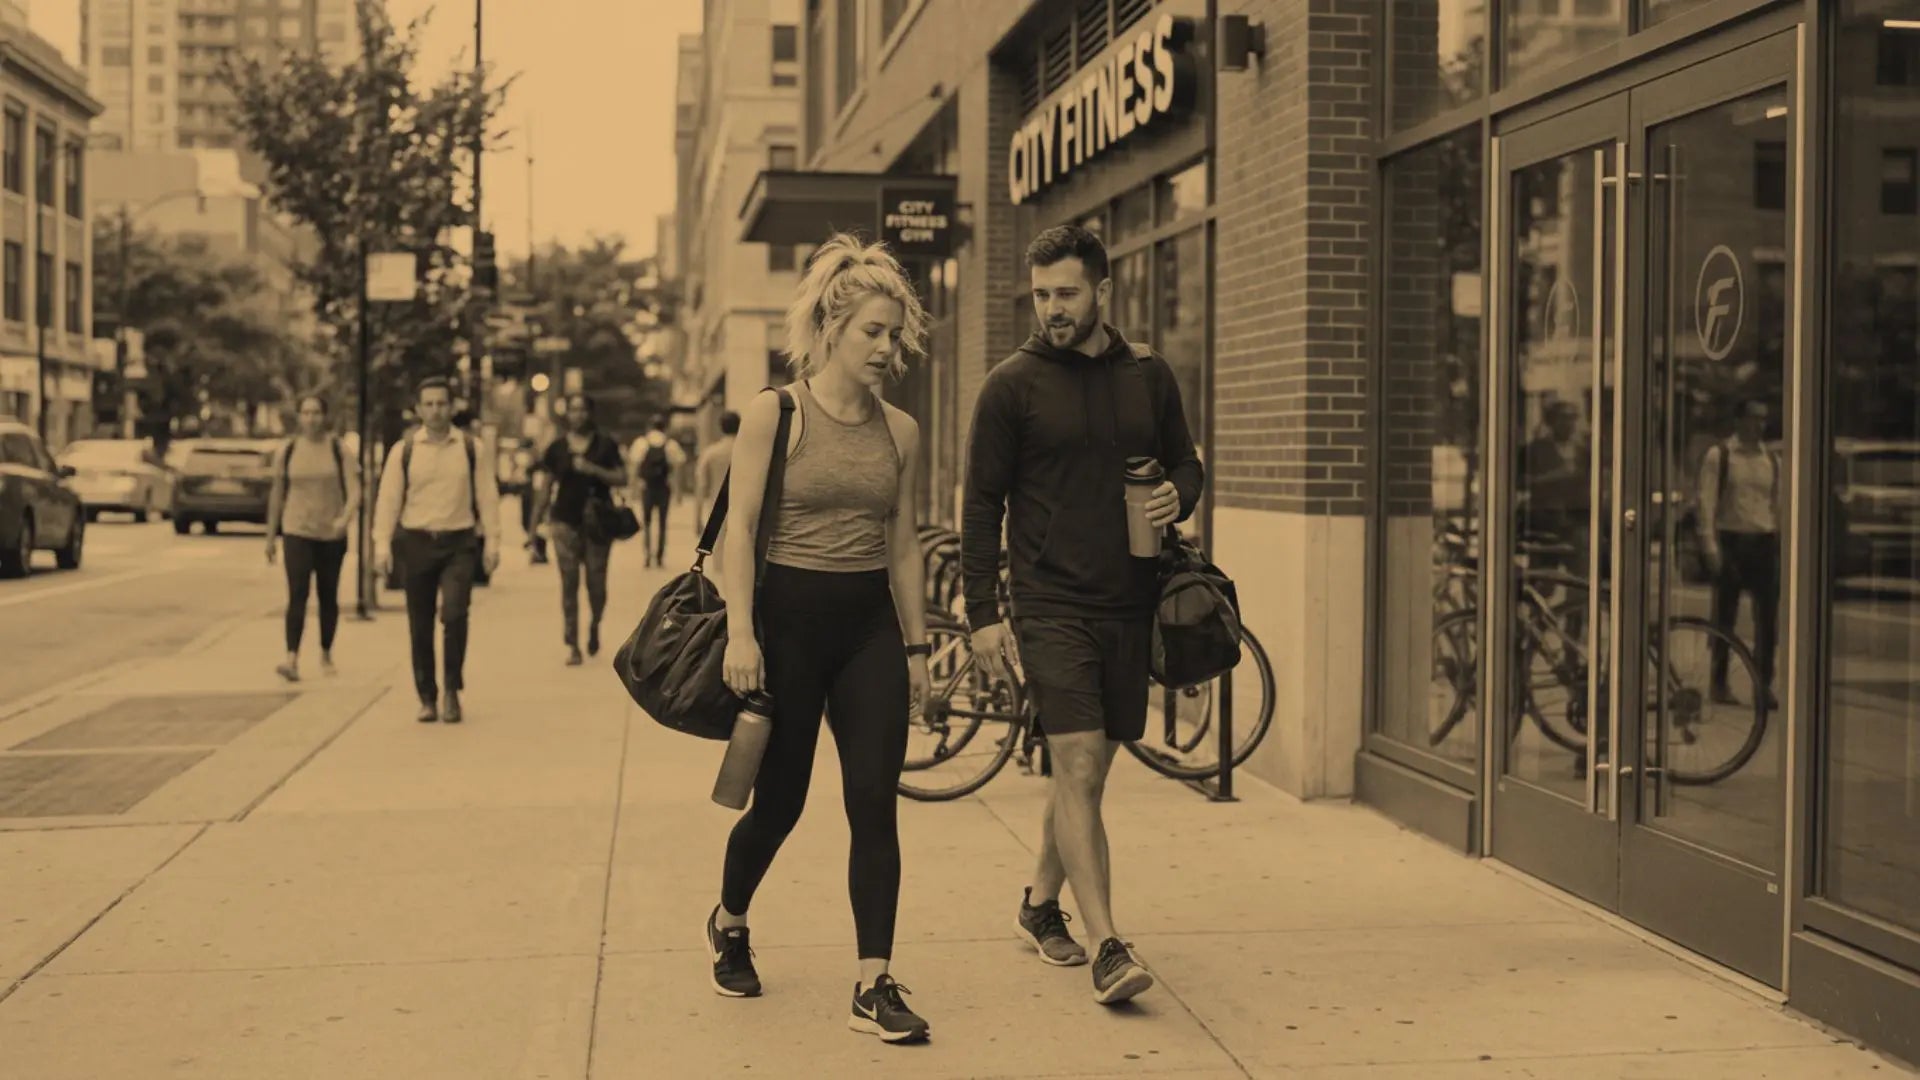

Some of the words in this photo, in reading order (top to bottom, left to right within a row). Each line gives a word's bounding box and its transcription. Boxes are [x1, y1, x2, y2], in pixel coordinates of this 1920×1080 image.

[1009, 103, 1058, 205] CITY
[1059, 13, 1174, 174] FITNESS
[899, 200, 935, 214] CITY
